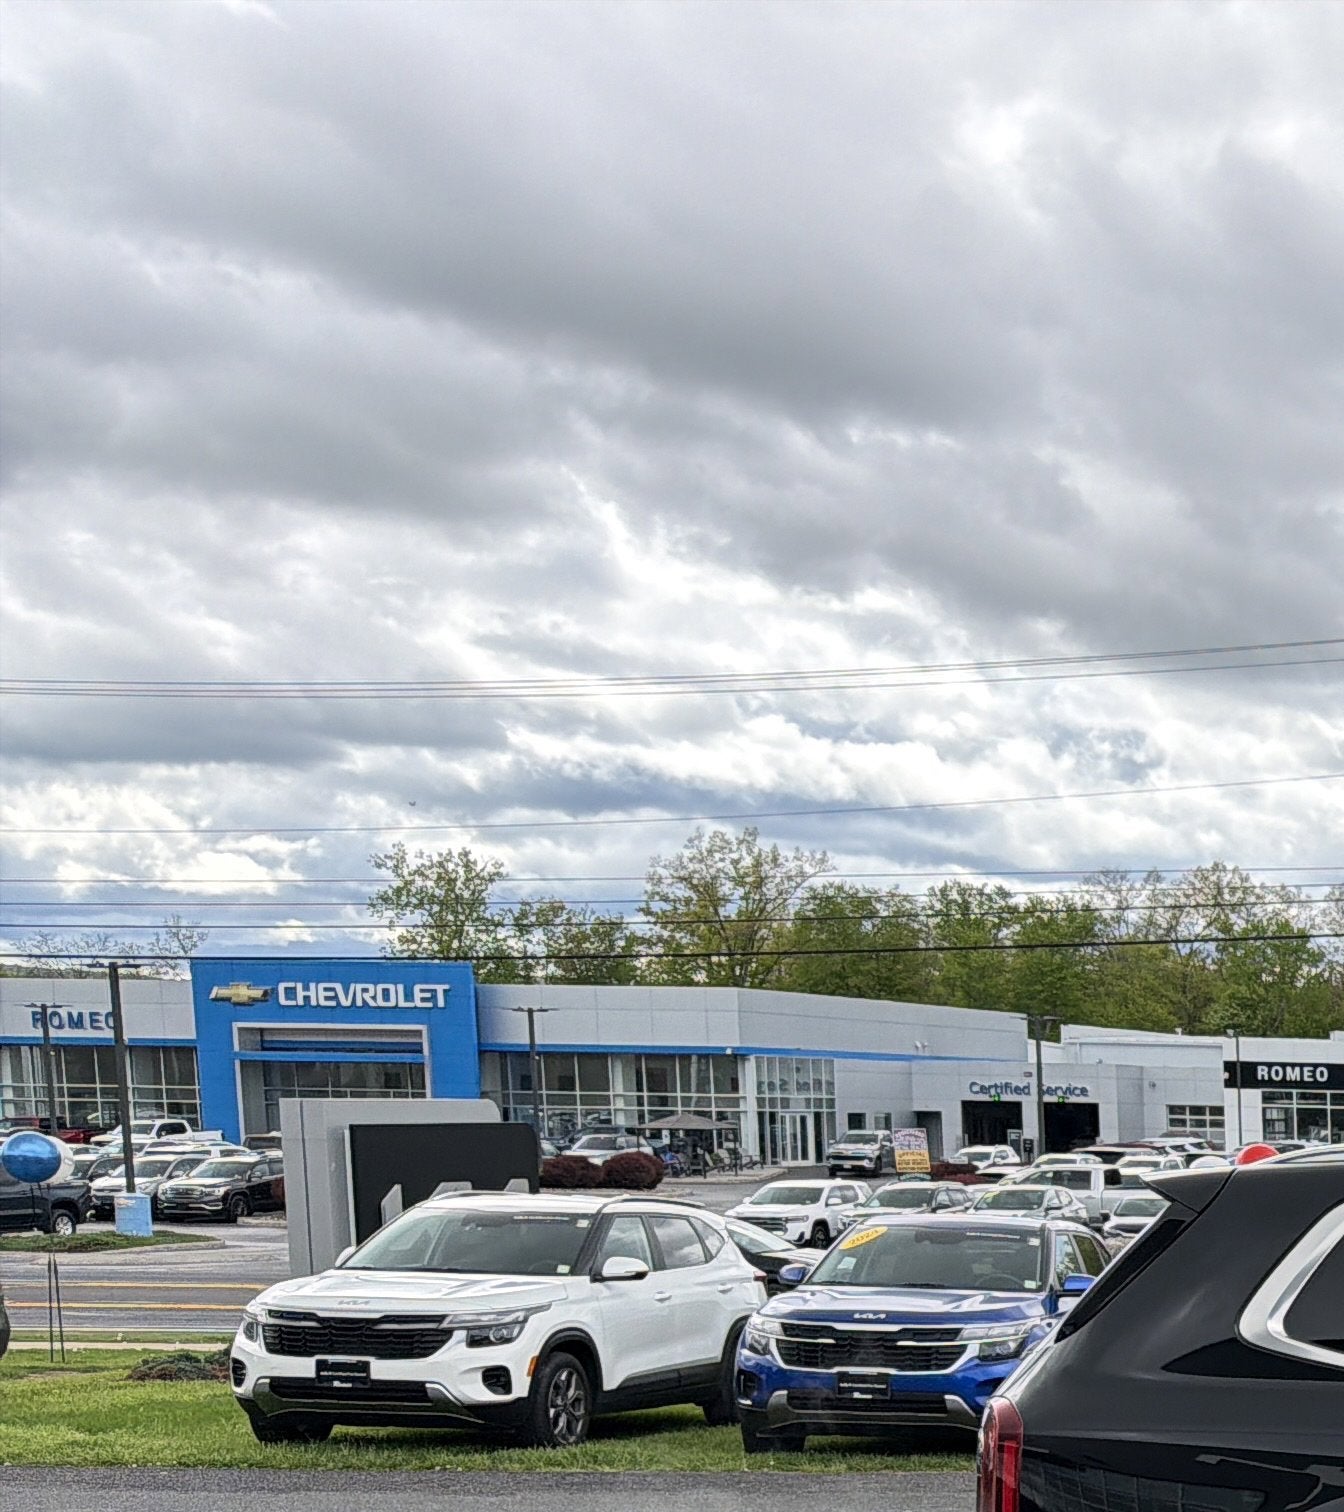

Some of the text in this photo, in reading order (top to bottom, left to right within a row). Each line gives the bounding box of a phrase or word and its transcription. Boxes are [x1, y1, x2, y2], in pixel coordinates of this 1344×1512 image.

[277, 981, 450, 1008] CHEVROLET
[31, 1010, 115, 1031] ROMEO
[1256, 1065, 1329, 1082] ROMEO
[968, 1081, 1031, 1097] Certified
